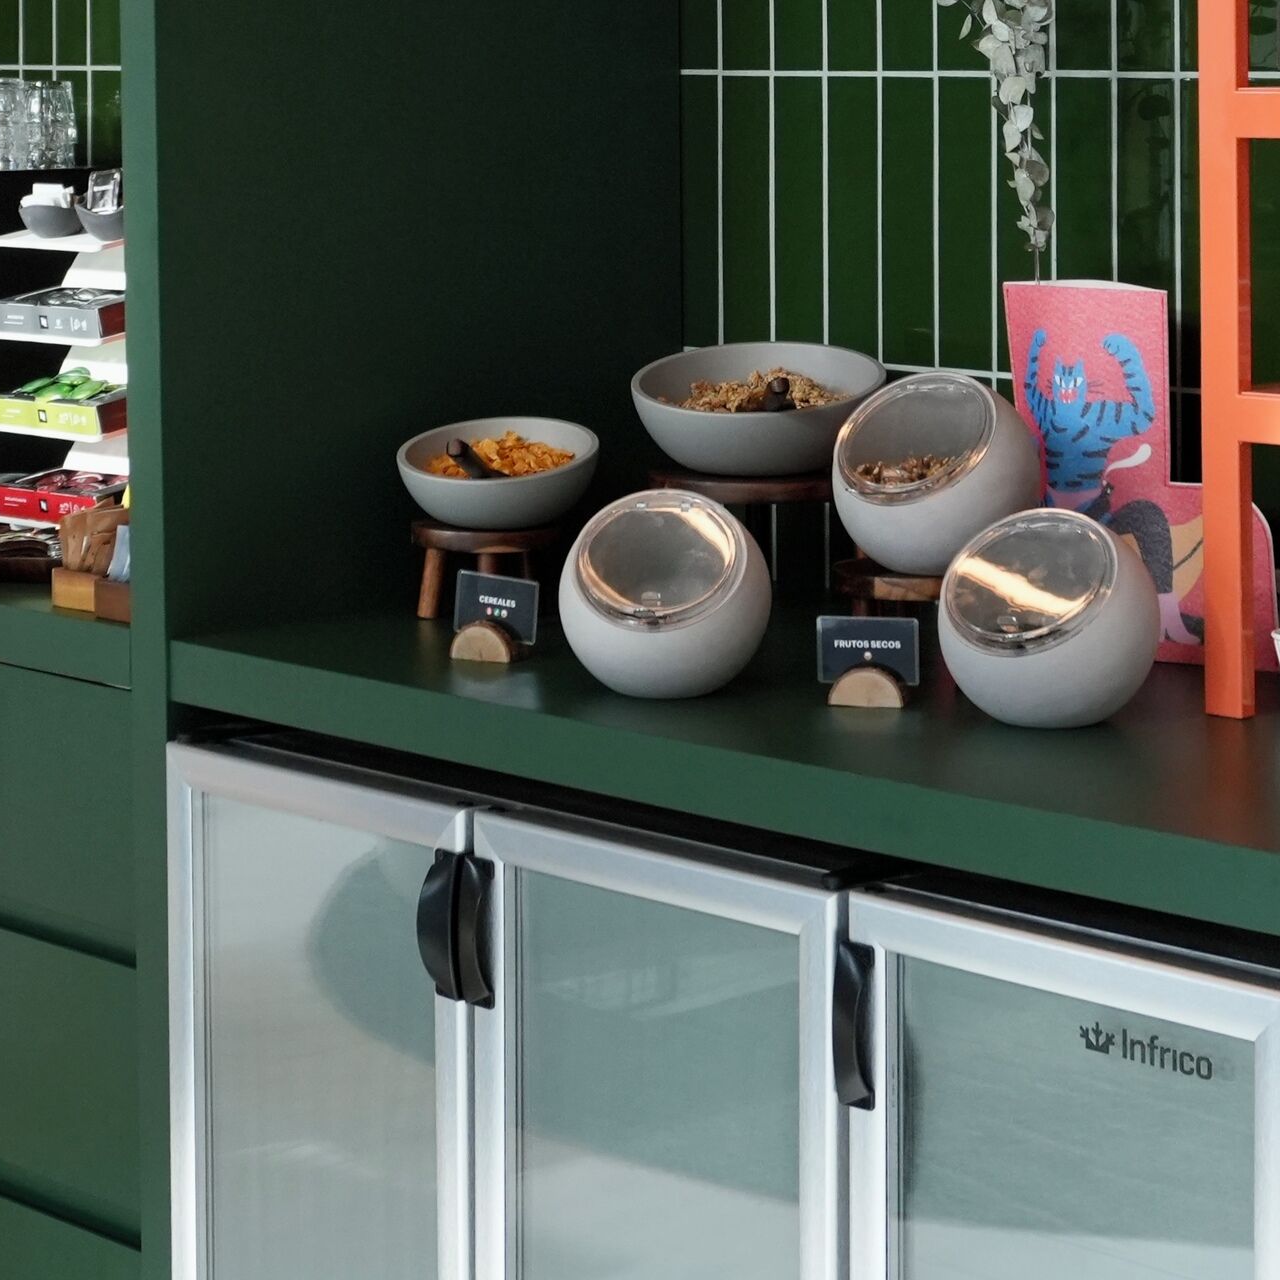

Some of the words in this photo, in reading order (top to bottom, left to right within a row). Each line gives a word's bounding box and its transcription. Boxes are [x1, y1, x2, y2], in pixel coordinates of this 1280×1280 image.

[479, 595, 516, 608] CEREALES
[834, 639, 869, 649] FRUTOS
[870, 640, 901, 649] SECOS
